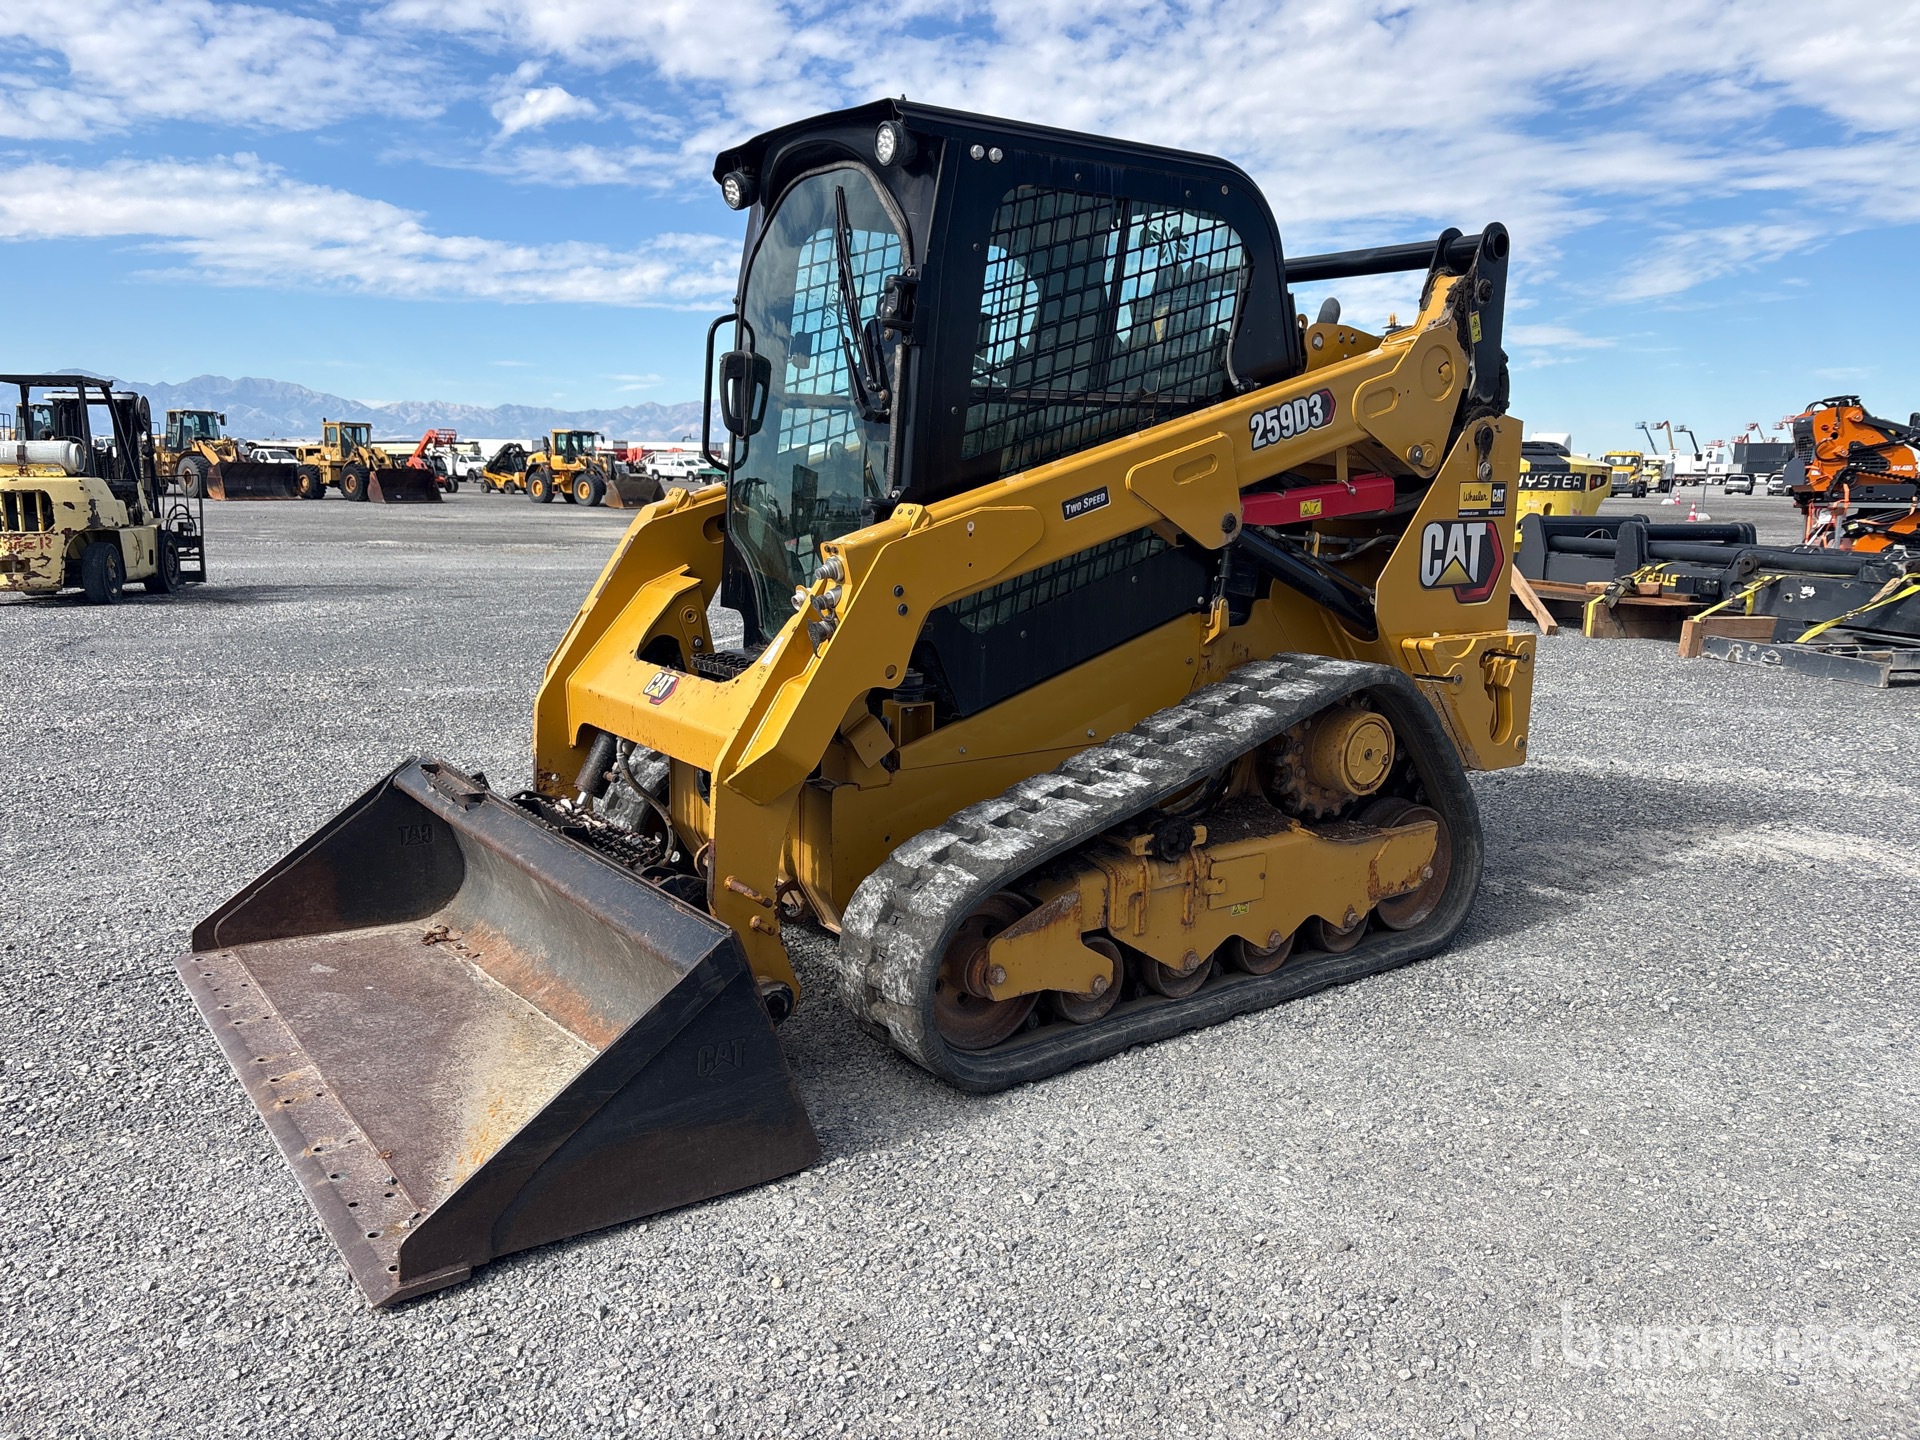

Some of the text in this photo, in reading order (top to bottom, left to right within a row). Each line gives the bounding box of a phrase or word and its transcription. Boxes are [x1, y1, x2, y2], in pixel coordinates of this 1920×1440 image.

[1250, 393, 1324, 448] 259D3
[1706, 451, 1713, 459] 4
[1463, 489, 1505, 503] Wheeler CAT
[1421, 522, 1487, 587] CAT
[643, 671, 678, 699] CAT
[698, 1039, 746, 1078] CAT
